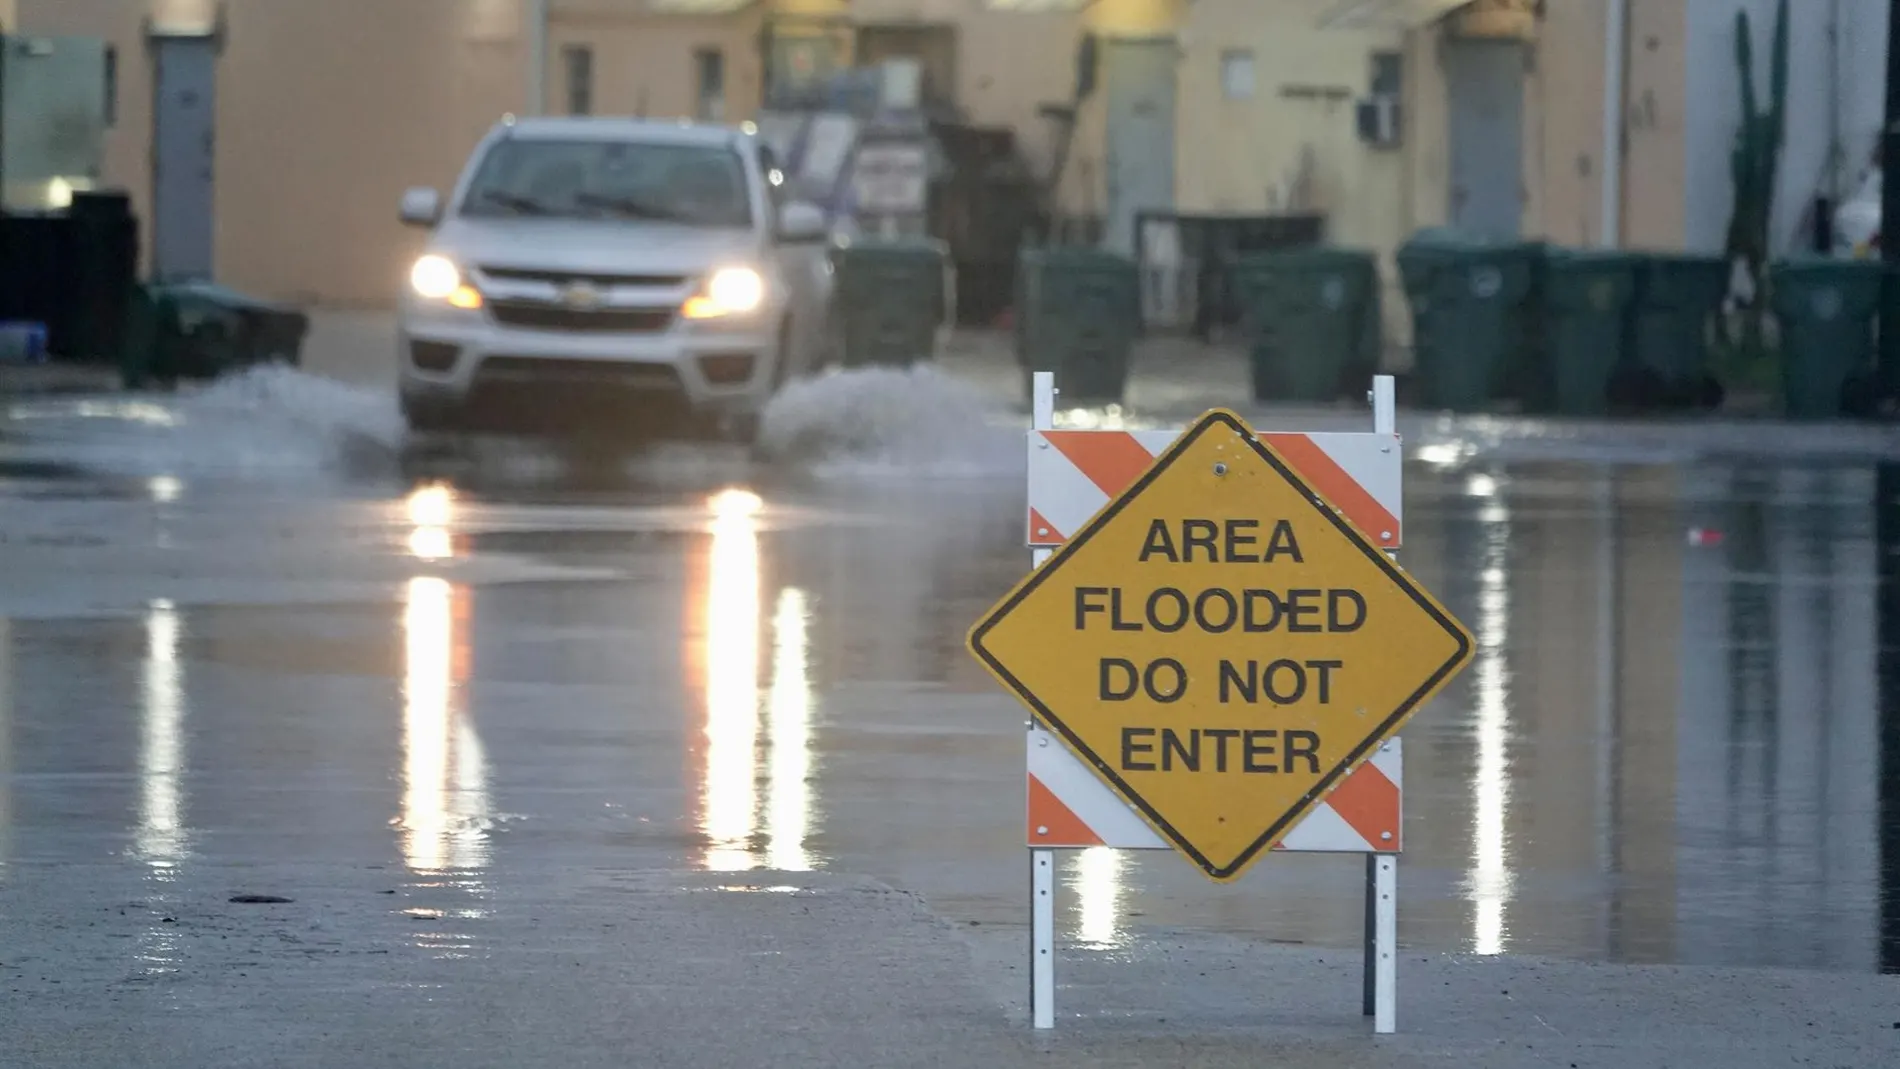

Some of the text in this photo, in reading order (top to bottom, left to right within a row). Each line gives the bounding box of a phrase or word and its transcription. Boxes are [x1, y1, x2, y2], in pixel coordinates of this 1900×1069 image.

[1138, 519, 1304, 563] AREA
[1074, 586, 1368, 633] FLOODED
[1099, 657, 1343, 705] DO NOT
[1121, 727, 1321, 774] ENTER
